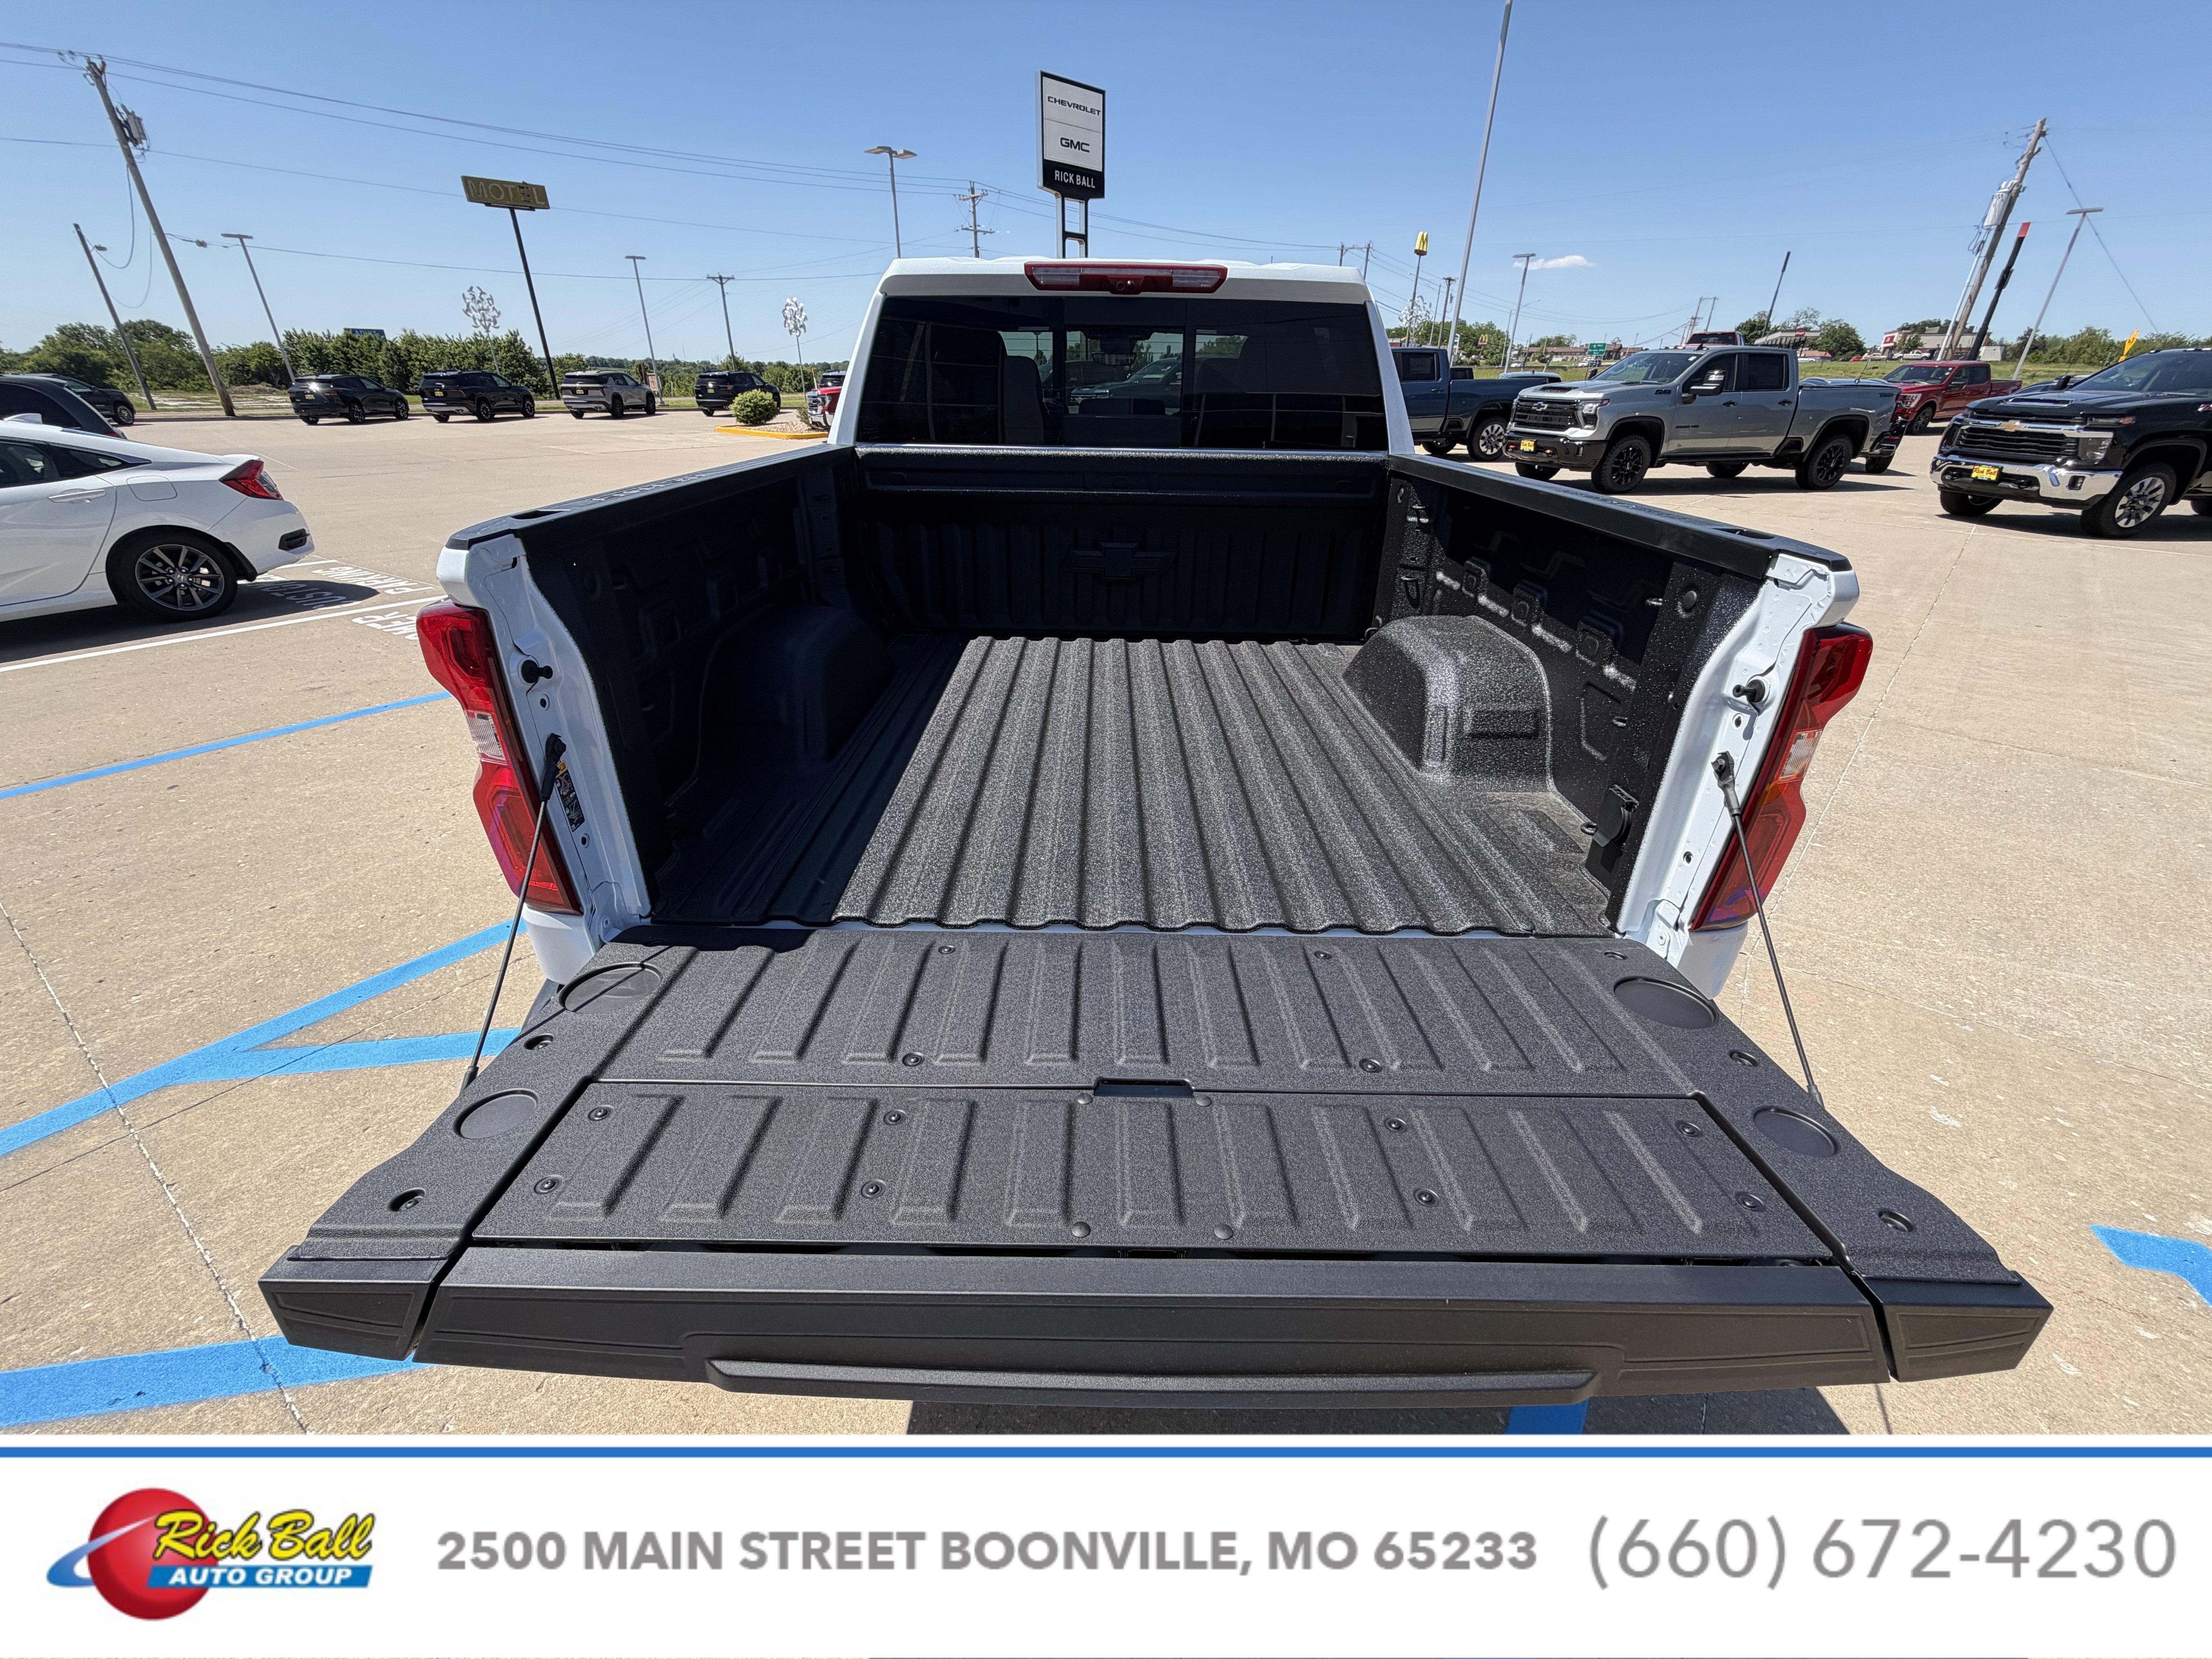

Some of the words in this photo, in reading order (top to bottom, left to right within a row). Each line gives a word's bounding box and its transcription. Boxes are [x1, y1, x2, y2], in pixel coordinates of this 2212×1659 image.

[1048, 96, 1101, 116] CHEVROLET
[1060, 137, 1090, 153] GMC
[1054, 170, 1074, 184] RICK
[1076, 175, 1096, 189] BALL
[312, 567, 433, 594] PARKING
